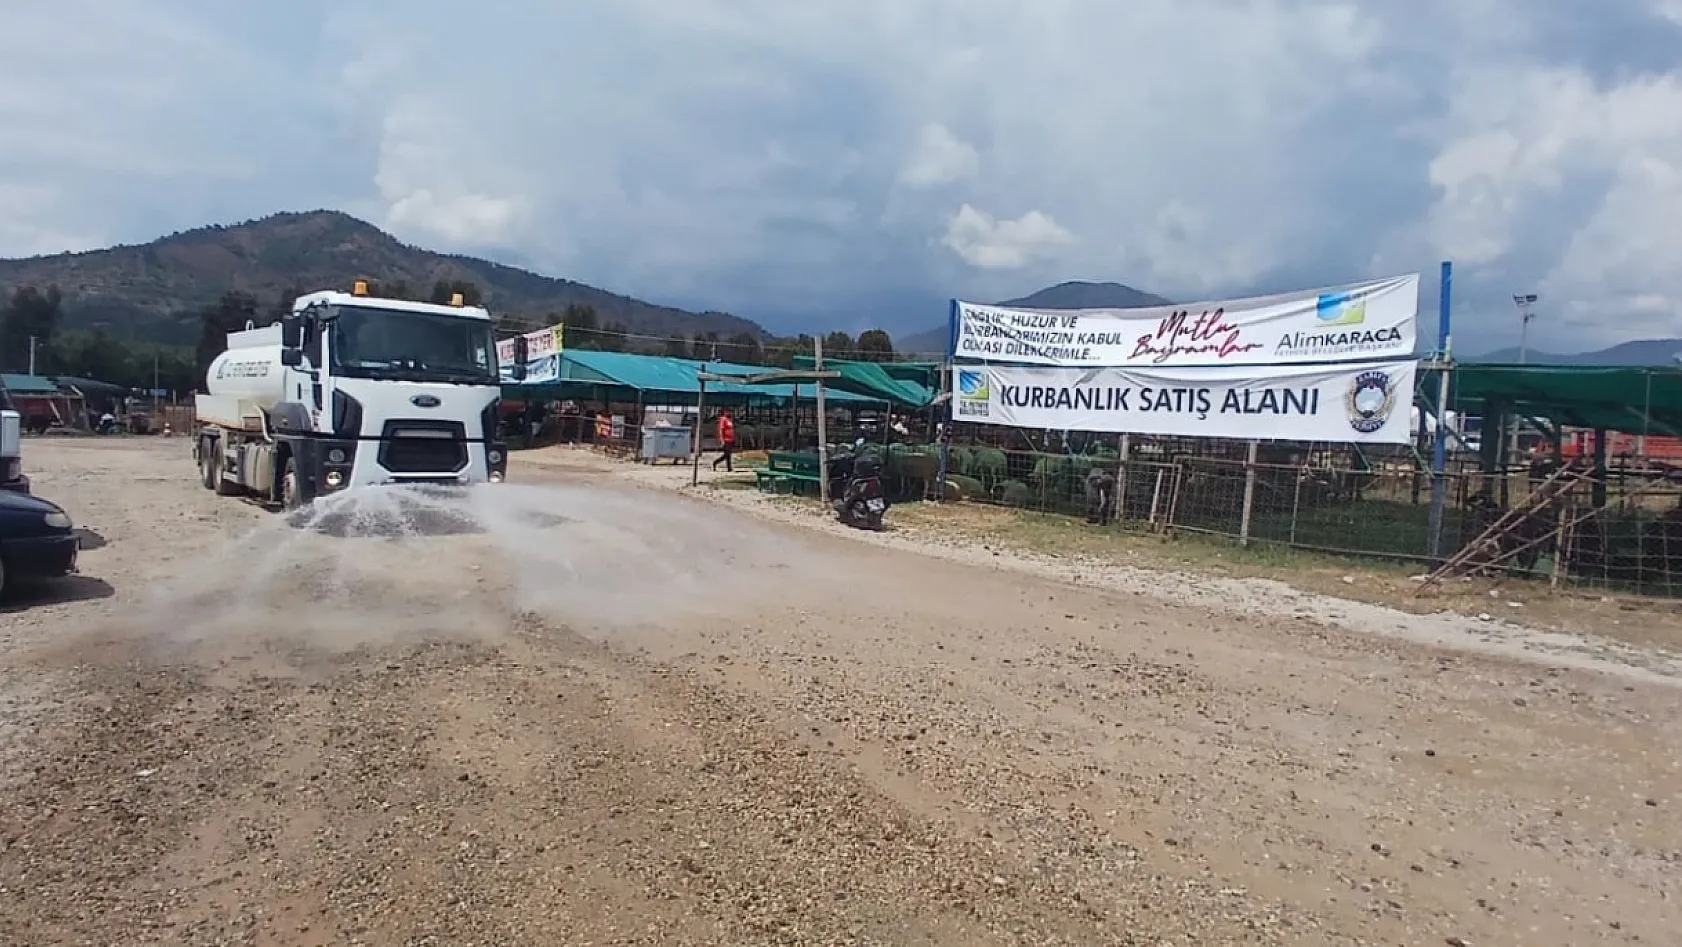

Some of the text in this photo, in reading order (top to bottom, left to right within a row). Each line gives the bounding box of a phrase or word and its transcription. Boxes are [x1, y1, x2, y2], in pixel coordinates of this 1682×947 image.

[1011, 314, 1057, 328] HUZUR
[1061, 315, 1078, 329] VE
[1155, 308, 1238, 346] Mutlu
[1076, 332, 1123, 346] KABUL
[1126, 330, 1264, 364] Bayramlar
[1276, 325, 1403, 350] AlimKARACA
[1000, 383, 1131, 411] KURBANLIK
[1138, 386, 1211, 420] SATIŞ
[1220, 387, 1319, 415] ALANI
